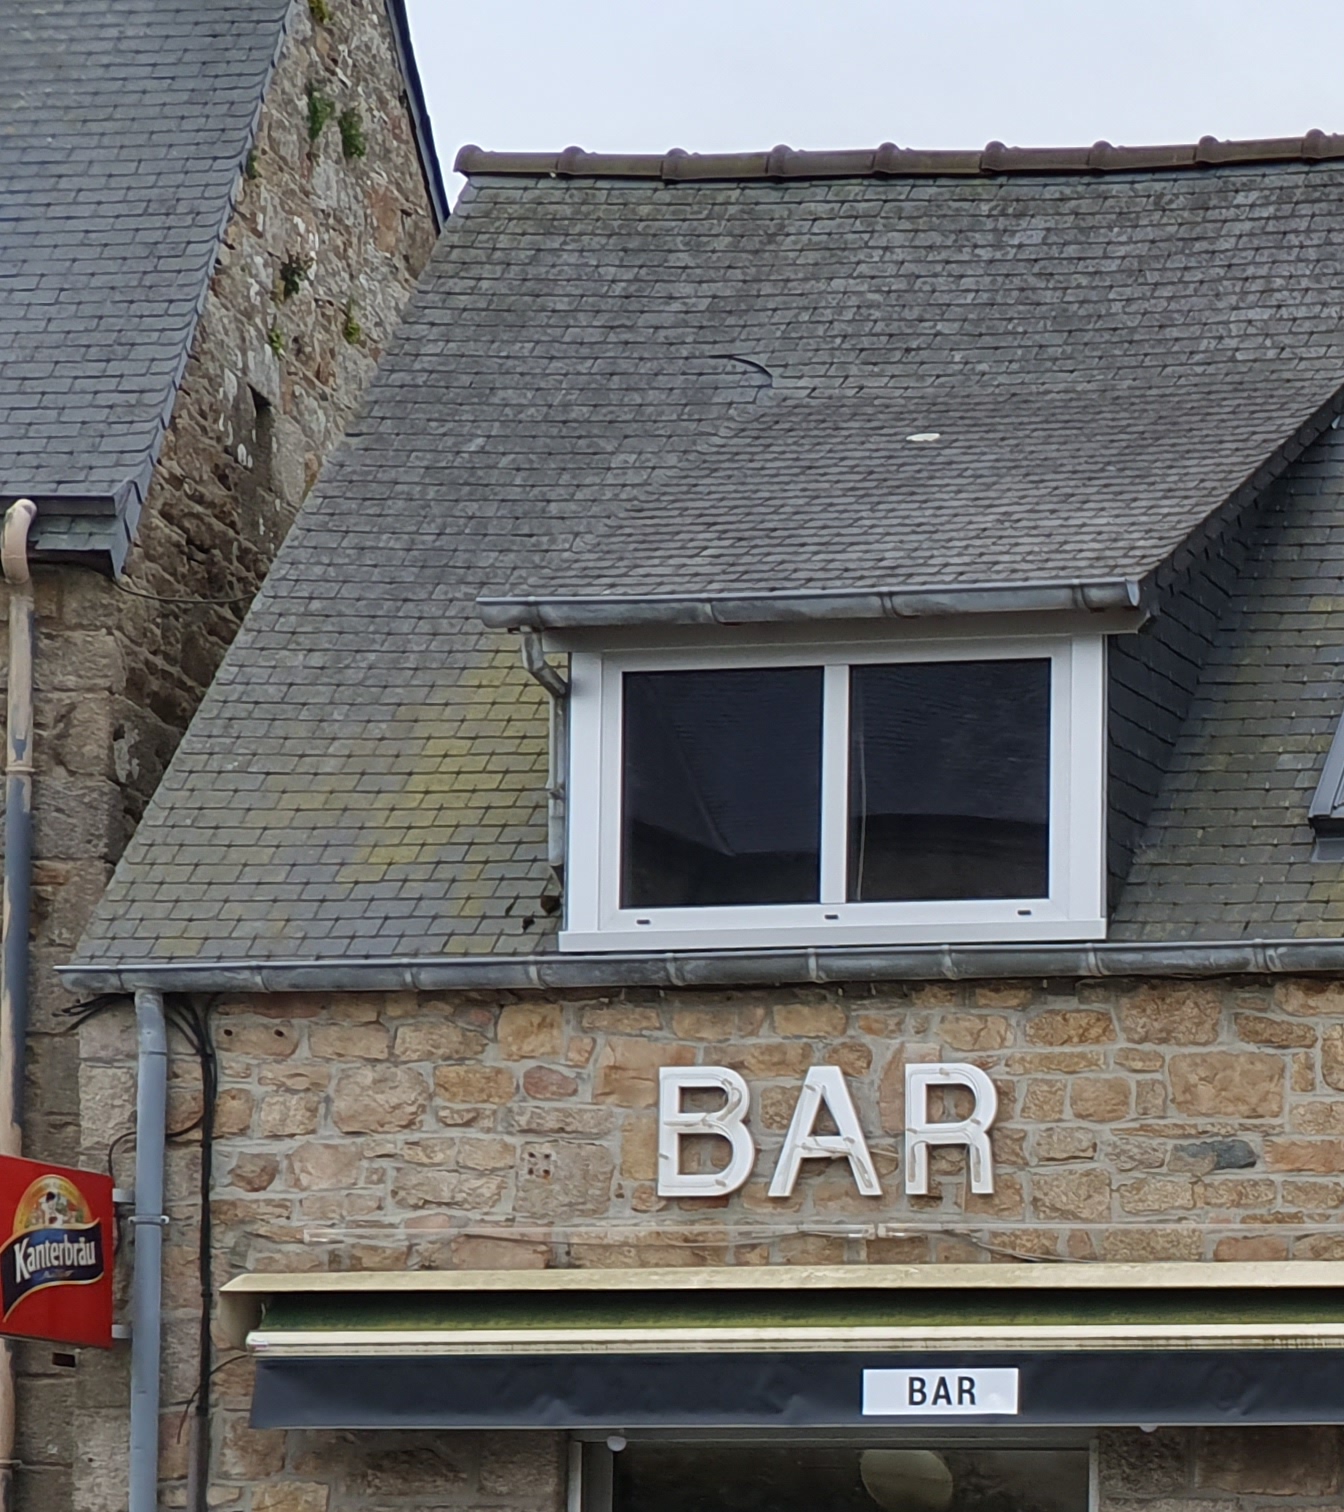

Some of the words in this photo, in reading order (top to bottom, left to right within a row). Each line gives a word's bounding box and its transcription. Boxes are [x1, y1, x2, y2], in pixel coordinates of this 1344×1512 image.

[657, 1063, 998, 1196] BAR
[13, 1233, 97, 1284] Kanterbräu
[908, 1376, 977, 1406] BAR
